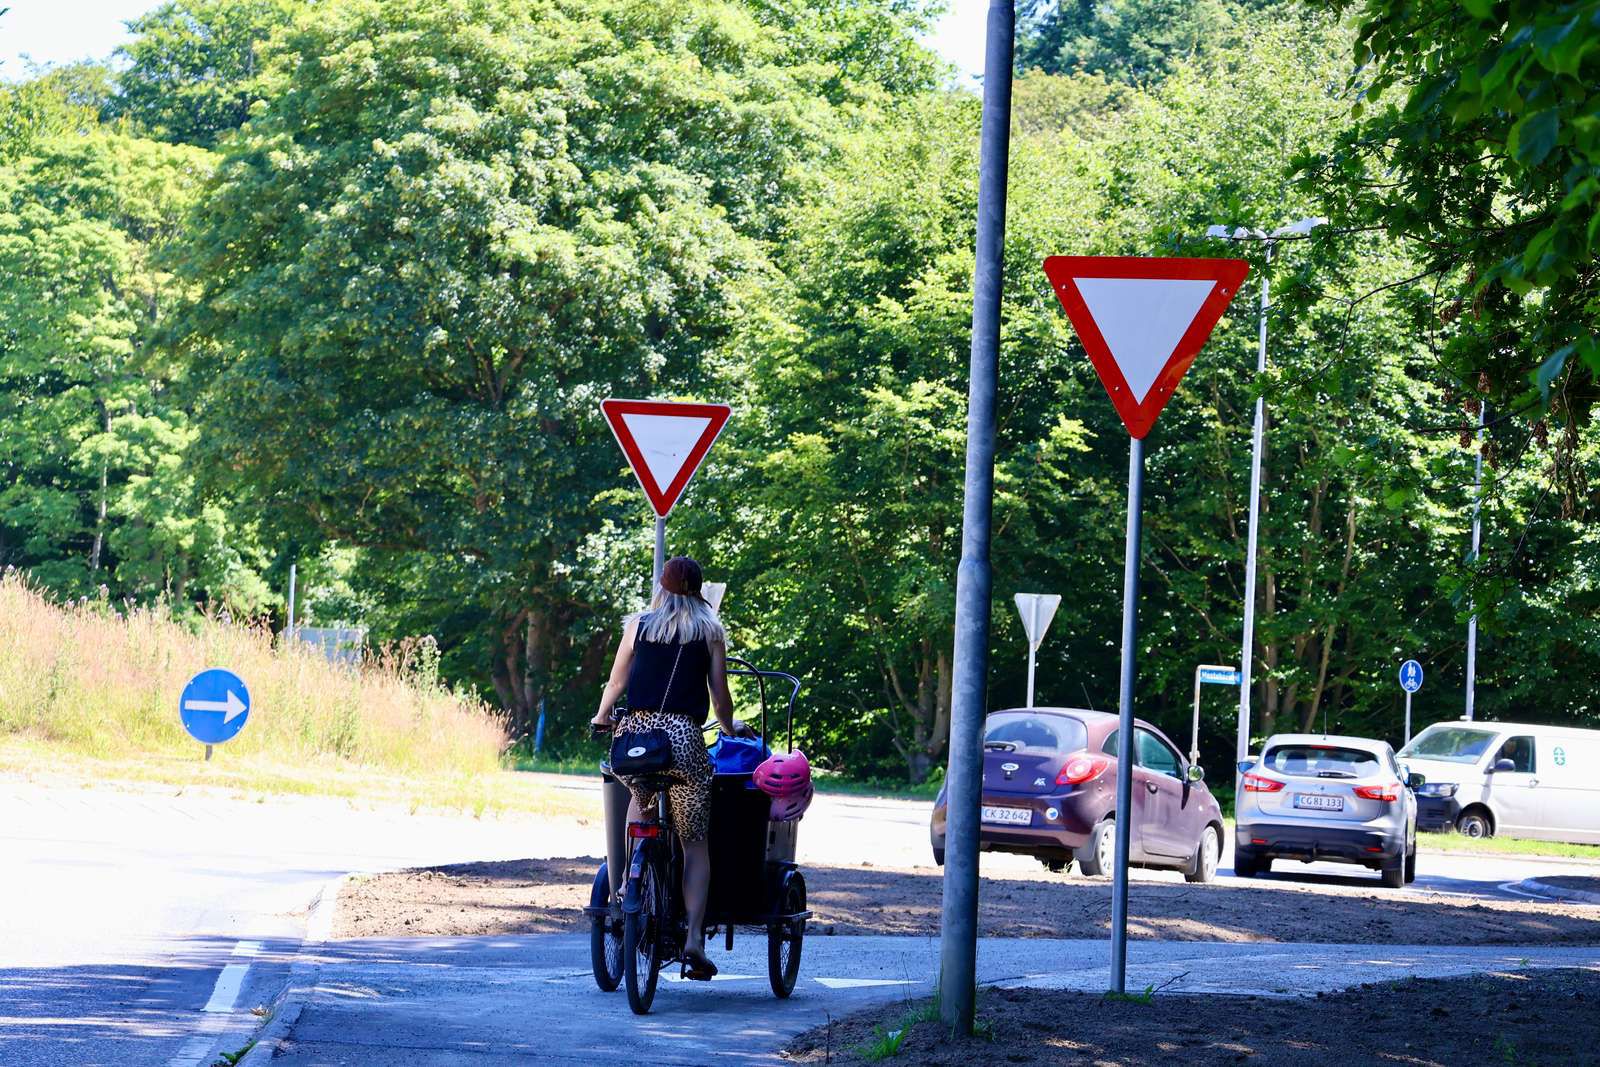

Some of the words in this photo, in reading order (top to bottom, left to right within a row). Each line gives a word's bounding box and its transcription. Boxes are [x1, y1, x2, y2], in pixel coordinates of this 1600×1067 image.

[1326, 798, 1342, 807] 133
[984, 808, 996, 818] CK
[999, 809, 1011, 820] 32
[1012, 810, 1030, 821] 642
